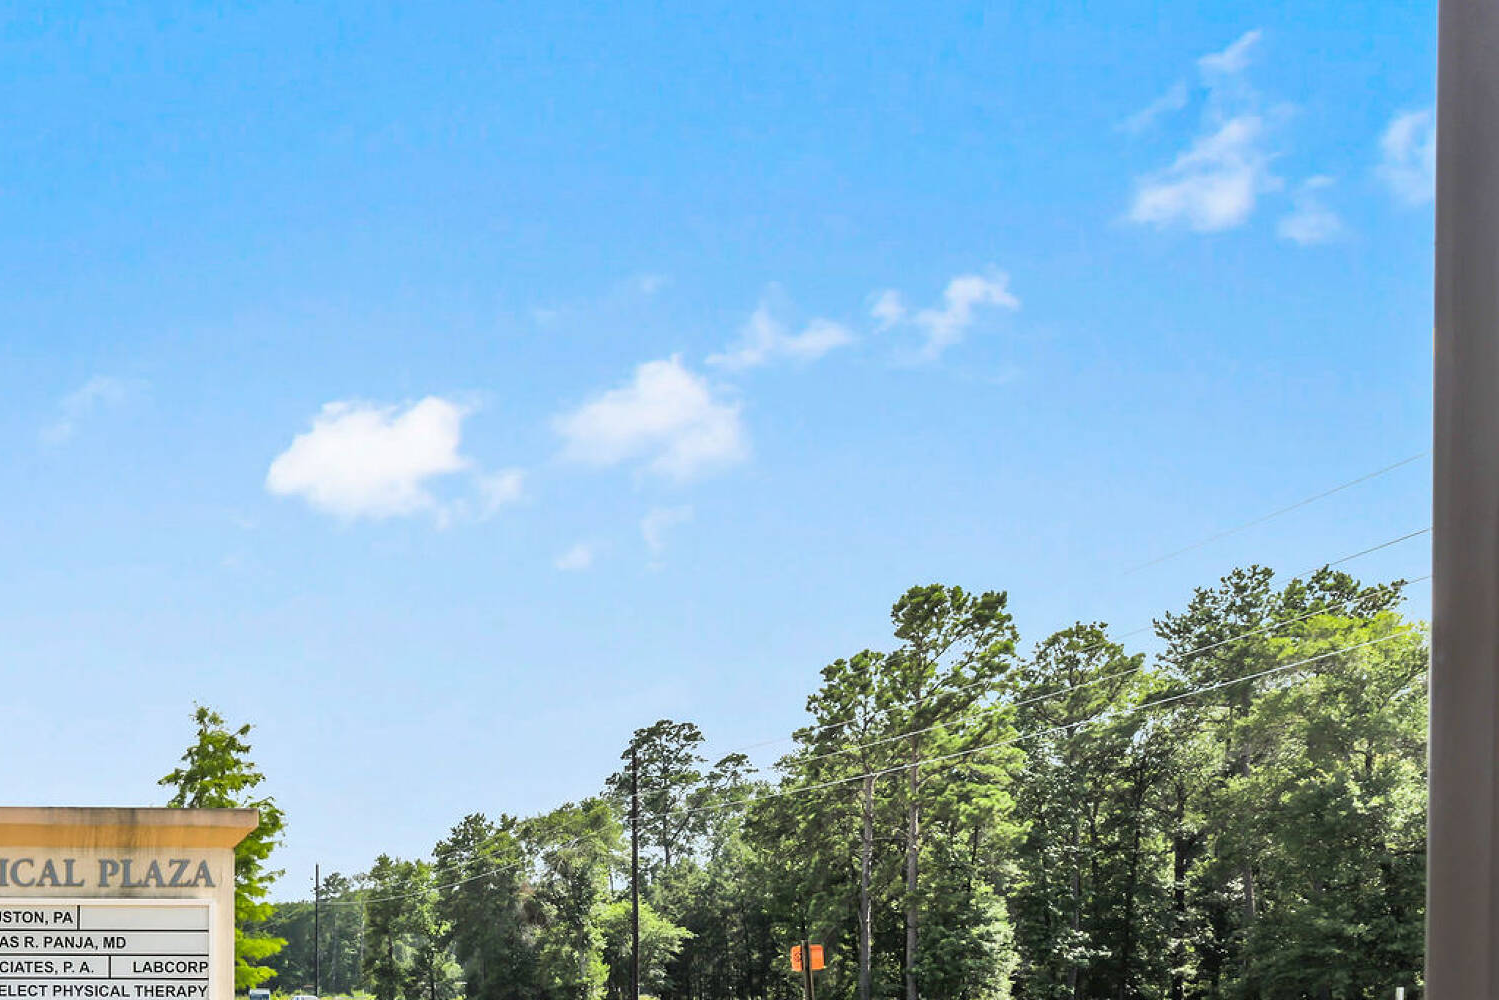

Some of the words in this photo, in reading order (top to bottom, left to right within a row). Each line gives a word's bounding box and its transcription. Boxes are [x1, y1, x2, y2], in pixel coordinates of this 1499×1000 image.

[98, 858, 216, 888] PLAZA
[53, 911, 74, 924] PA
[24, 937, 39, 949] R.
[43, 937, 99, 950] PANJA,
[103, 937, 127, 949] MD
[63, 962, 75, 974] P.
[79, 962, 94, 974] A.
[133, 961, 209, 974] LABCORP
[52, 985, 131, 998] PHYSICAL
[134, 985, 208, 998] THERAPY
